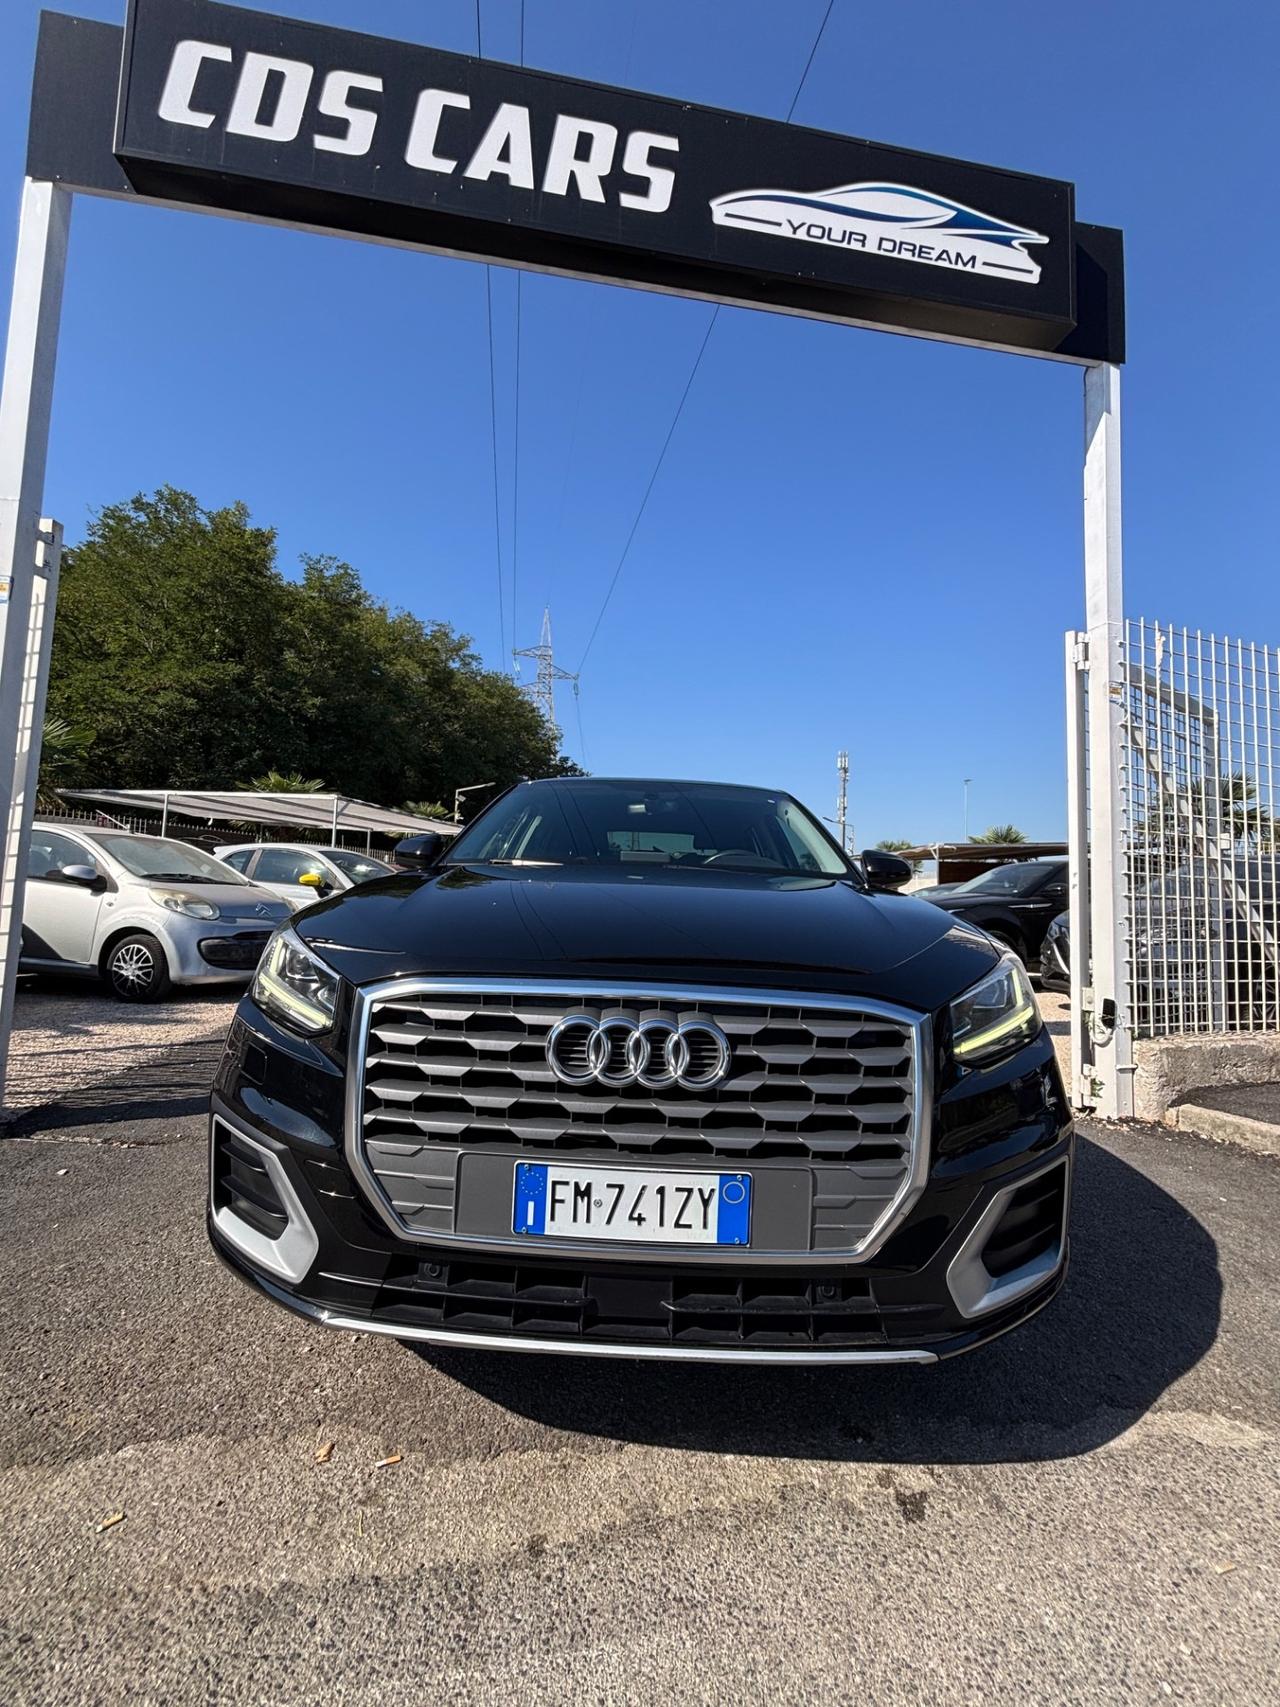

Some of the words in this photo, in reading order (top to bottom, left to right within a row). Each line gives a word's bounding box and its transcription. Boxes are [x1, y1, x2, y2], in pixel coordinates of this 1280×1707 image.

[157, 39, 384, 156] CDS
[405, 88, 680, 213] CARS
[786, 218, 868, 248] YOUR
[877, 236, 977, 269] DREAM
